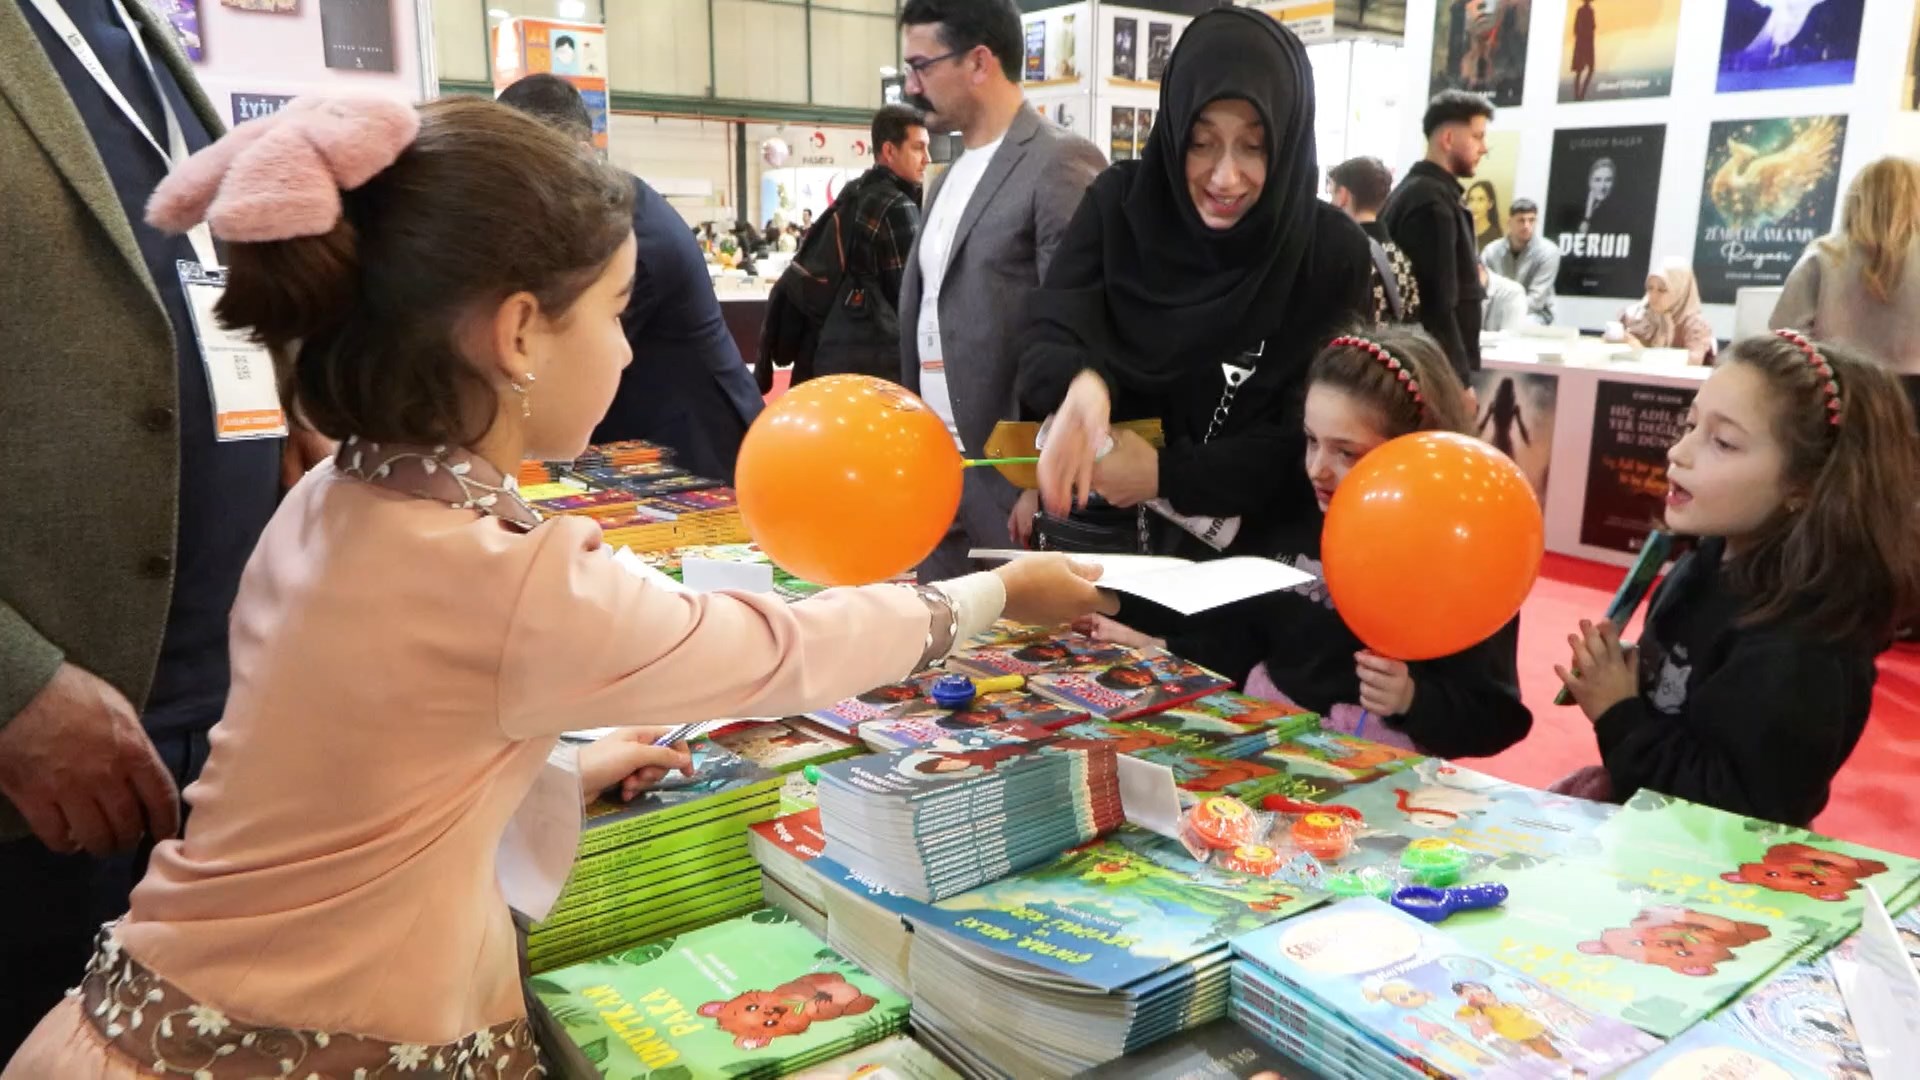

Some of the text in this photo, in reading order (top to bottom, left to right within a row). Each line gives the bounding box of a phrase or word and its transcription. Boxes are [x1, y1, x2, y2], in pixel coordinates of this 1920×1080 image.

[1559, 232, 1631, 258] DERUN
[580, 984, 681, 1070] UNUTKAN
[639, 987, 705, 1038] PAKA
